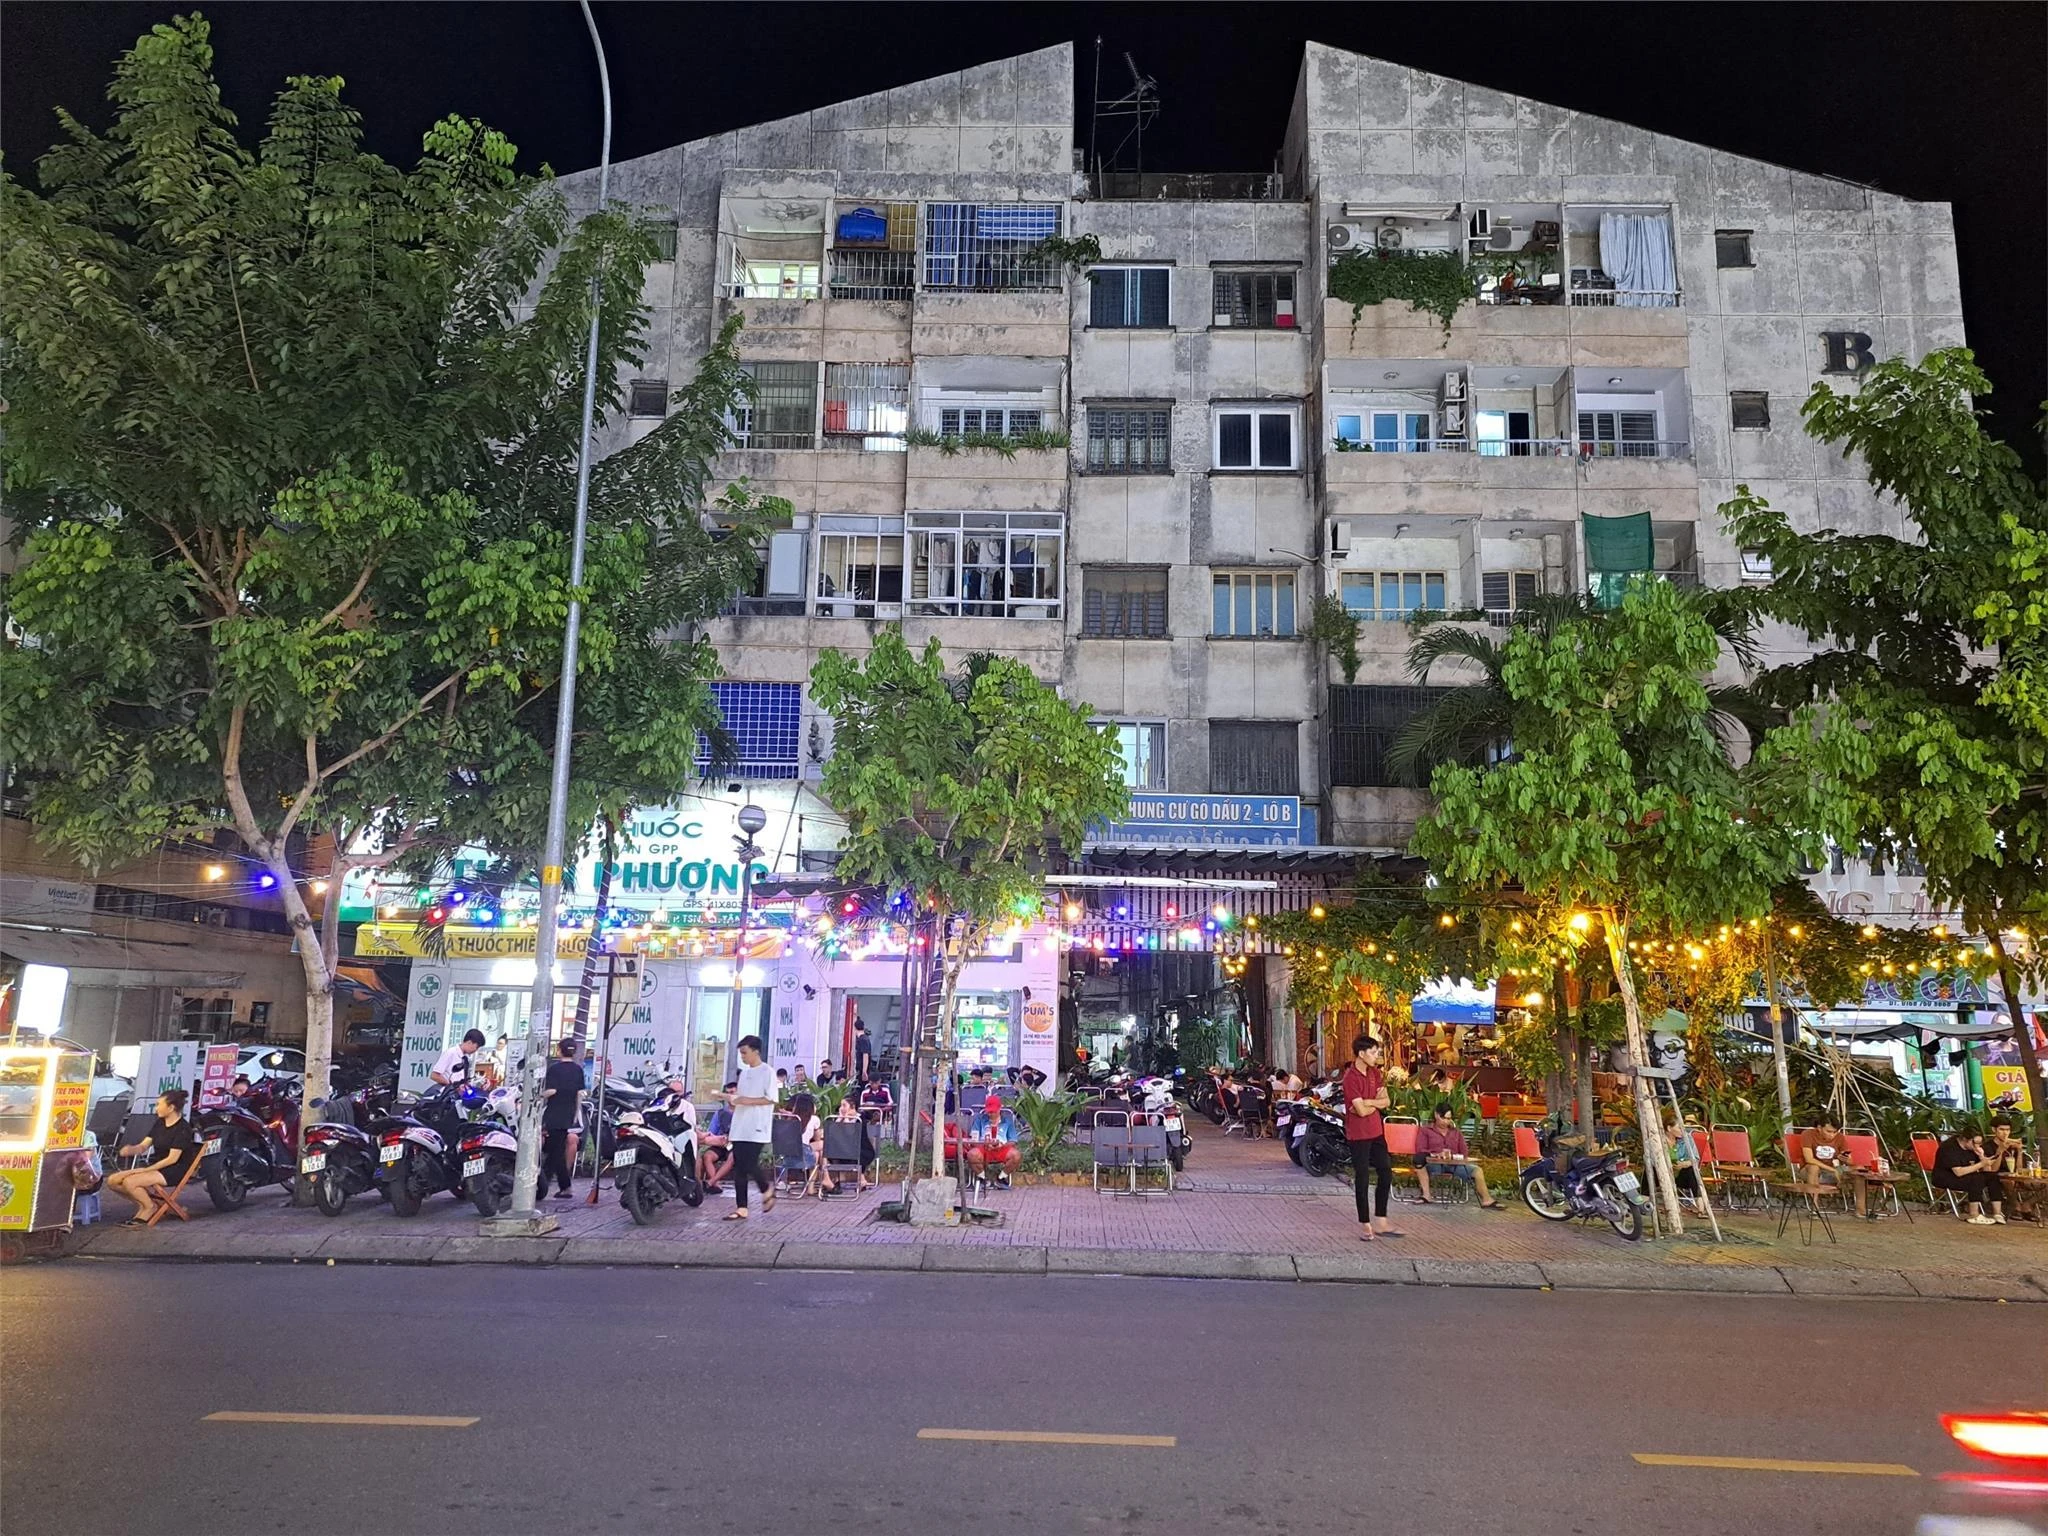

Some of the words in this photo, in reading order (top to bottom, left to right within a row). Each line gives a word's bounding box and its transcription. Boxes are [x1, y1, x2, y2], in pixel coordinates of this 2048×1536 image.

[1819, 332, 1875, 377] B
[1120, 801, 1164, 819] HUNG
[1168, 799, 1189, 820] CƯ
[1243, 804, 1251, 821] 2
[1263, 801, 1278, 822] LÔ
[1281, 805, 1291, 821] B
[623, 813, 704, 838] HUỐC
[649, 844, 678, 854] GPP
[459, 931, 506, 953] THUỐC
[507, 934, 537, 953] THIÊ
[414, 1008, 437, 1026] NHÀ
[632, 1002, 652, 1023] NHÀ
[780, 1002, 793, 1026] NHÀ
[1023, 1006, 1054, 1016] PUM'S
[405, 1032, 442, 1051] THUỐC
[624, 1030, 656, 1056] THUỐC
[776, 1031, 796, 1057] THUỐC
[411, 1060, 433, 1078] TÂY
